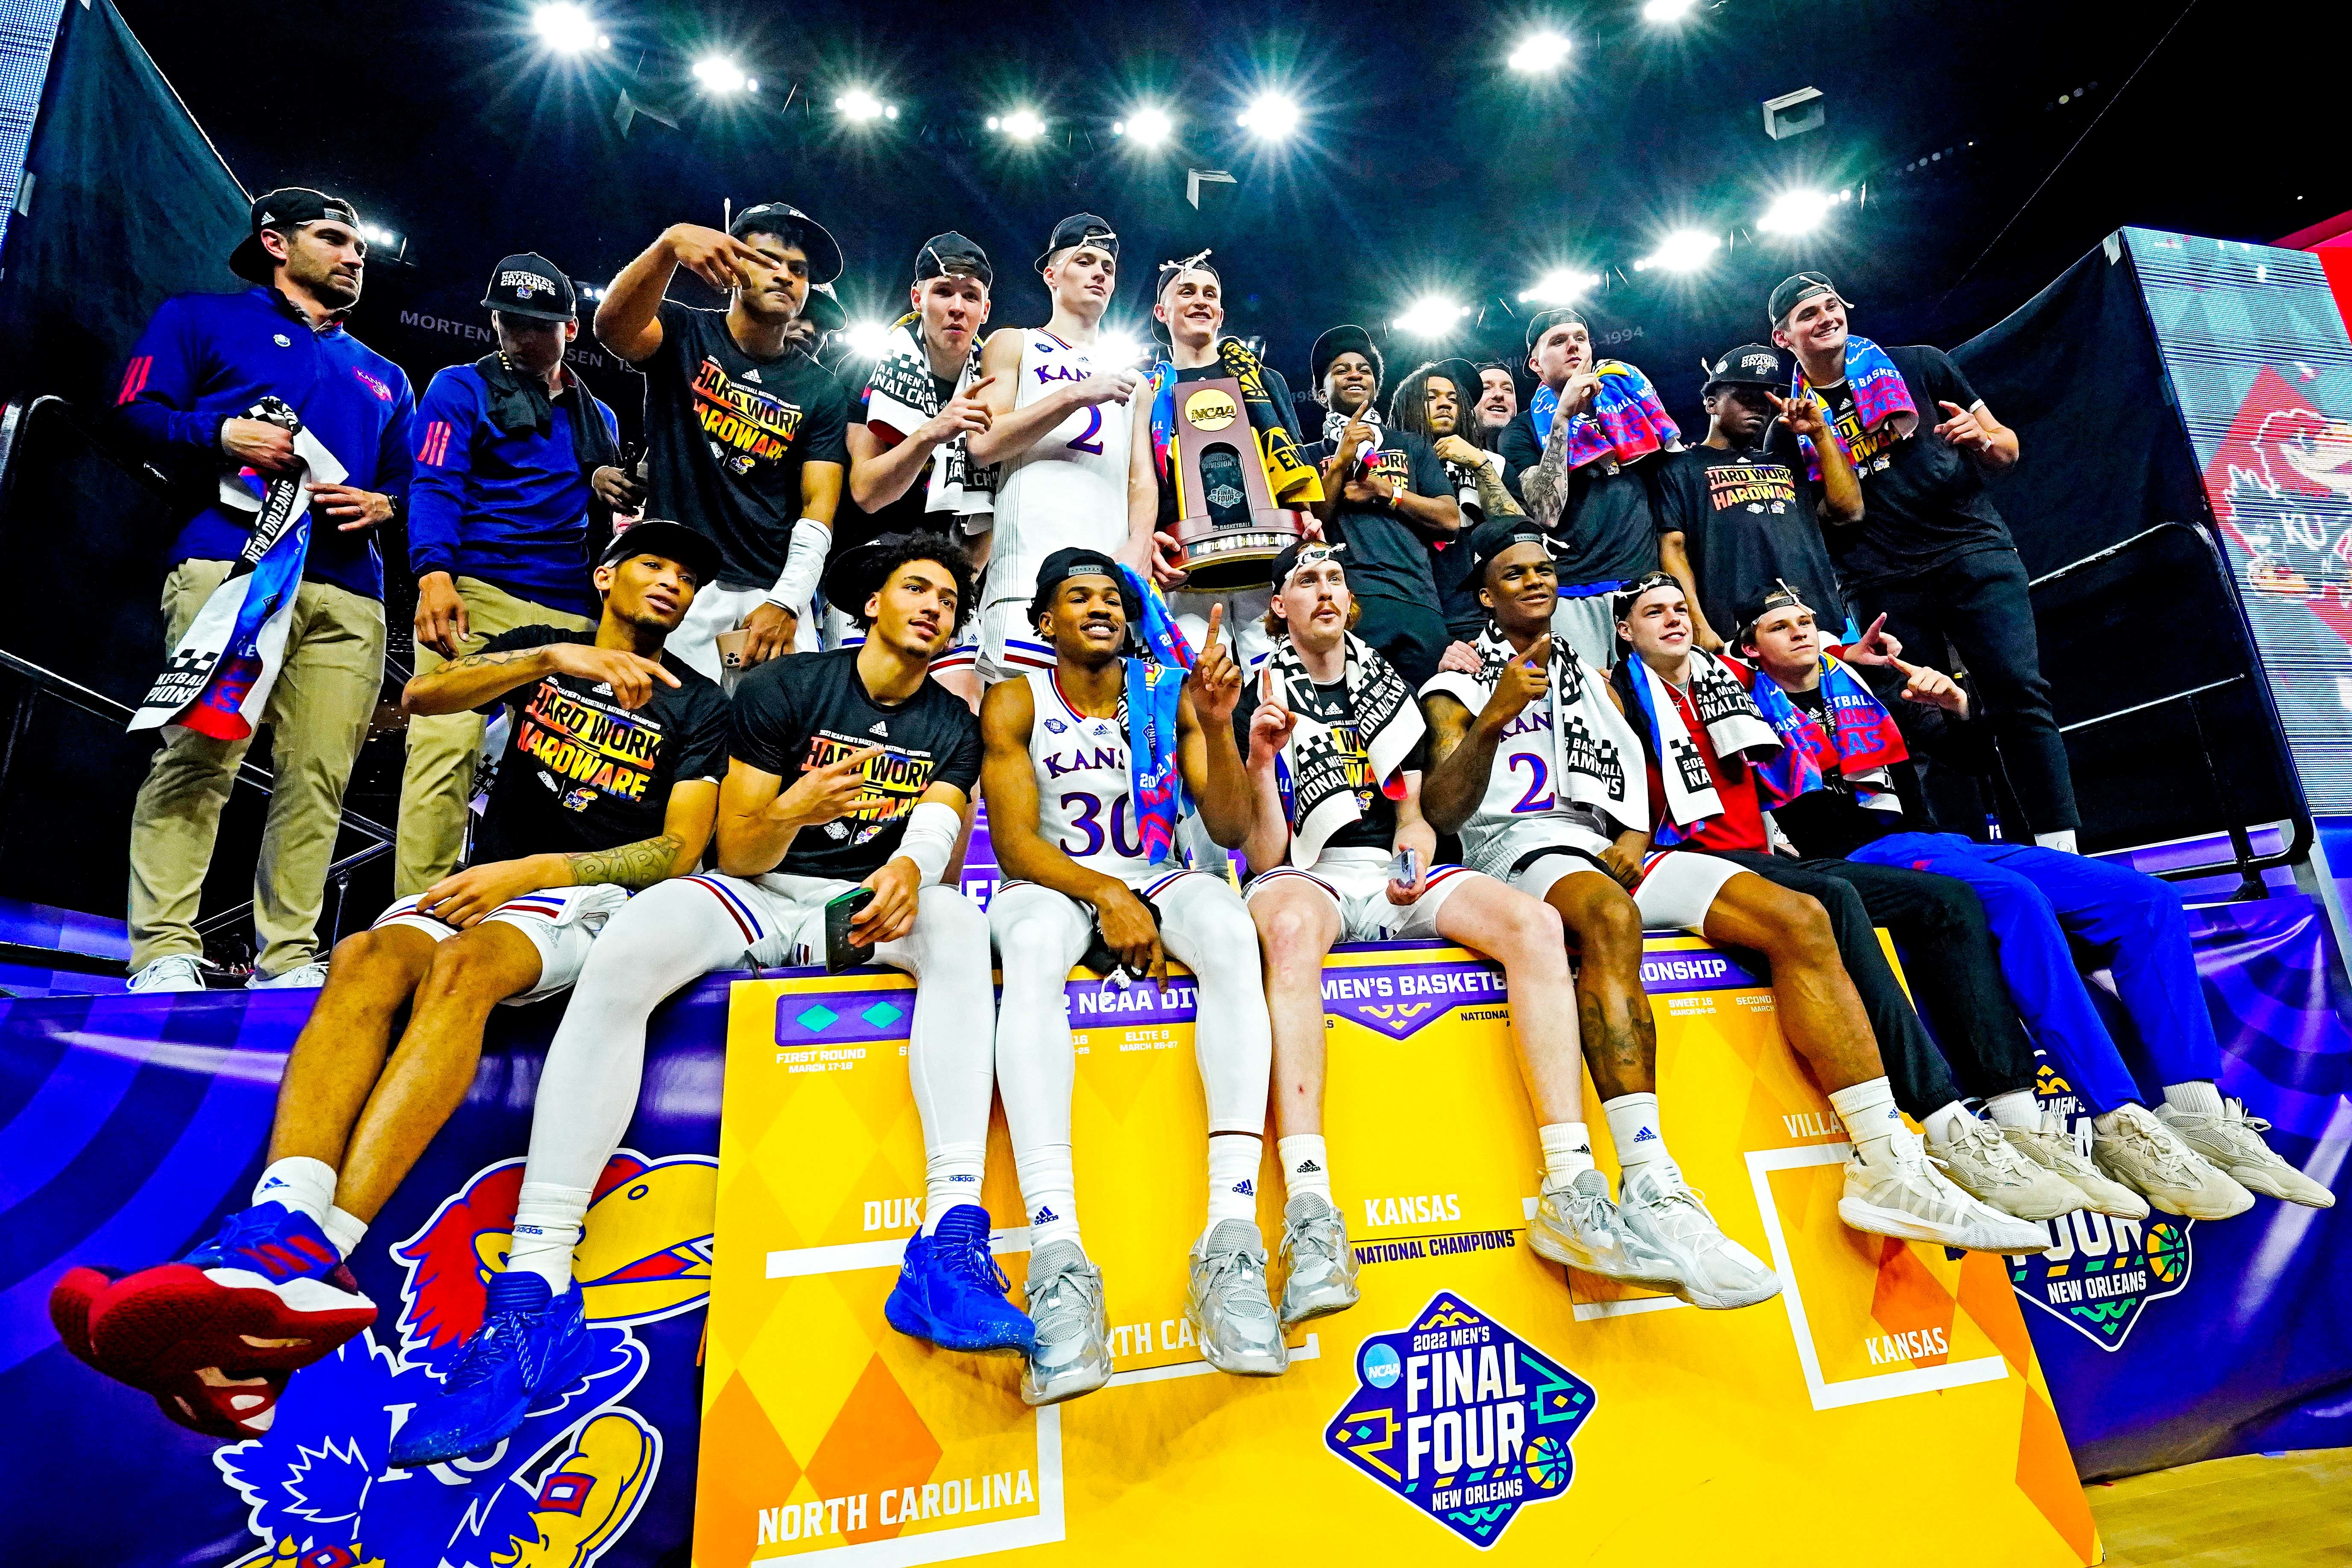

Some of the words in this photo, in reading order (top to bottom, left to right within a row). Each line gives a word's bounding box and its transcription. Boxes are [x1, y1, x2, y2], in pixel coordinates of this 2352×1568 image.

[400, 310, 491, 343] MORTEN
[731, 382, 758, 395] BASKETBALL
[1191, 405, 1236, 423] NCAA
[1709, 470, 1750, 486] HARD
[245, 531, 269, 564] NEW
[262, 479, 296, 540] ORLEANS
[1219, 522, 1251, 531] BASKETBALL
[592, 687, 614, 697] adidas
[580, 697, 607, 711] BASKETBALL
[606, 705, 630, 719] NATIONAL
[631, 711, 661, 731] CHAMPIONS
[588, 714, 664, 761] WORK
[869, 728, 889, 737] adidas
[517, 720, 651, 802] HARDWARE
[884, 745, 906, 755] NATIONAL
[1682, 756, 1706, 771] 202
[1509, 752, 1555, 813] 2
[1060, 791, 1145, 858] 30
[536, 922, 558, 949] adidas
[1079, 990, 1154, 1014] NCAA
[1321, 976, 1392, 1001] MEN'S
[1399, 971, 1508, 996] BASKETB
[1668, 997, 1700, 1008] SWEET
[1701, 997, 1713, 1006] 16
[1735, 995, 1772, 1005] SECOND
[1119, 1042, 1152, 1052] MARCH
[1153, 1040, 1178, 1050] 26-27
[1125, 1031, 1159, 1042] ELITE
[1160, 1030, 1170, 1040] 8
[776, 1051, 817, 1064] FIRST
[820, 1048, 866, 1061] ROUND
[788, 1063, 825, 1074] MARCH
[827, 1061, 853, 1071] 17-18
[1633, 1134, 1657, 1142] adidas
[1782, 1112, 1846, 1138] VILLA
[1232, 1187, 1254, 1196] adidas
[863, 1196, 925, 1232] DUK
[1034, 1215, 1059, 1225] adidas
[1364, 1193, 1461, 1227] KANSAS
[1356, 1240, 1426, 1266] NATIONAL
[1430, 1229, 1516, 1257] CHAMPIONS
[2047, 1279, 2084, 1304] NEW
[2085, 1270, 2147, 1301] ORLEANS
[1413, 1333, 1448, 1352] 2022
[1451, 1325, 1490, 1347] MEN'S
[1864, 1326, 1949, 1365] KANSAS
[1368, 1363, 1401, 1379] NCAA
[1407, 1342, 1526, 1414] FINAL
[1407, 1401, 1526, 1480] FOUR
[756, 1493, 869, 1546] NORTH
[879, 1468, 1036, 1526] CAROLINA
[1432, 1488, 1462, 1512] NEW
[1465, 1478, 1523, 1506] ORLEANS
